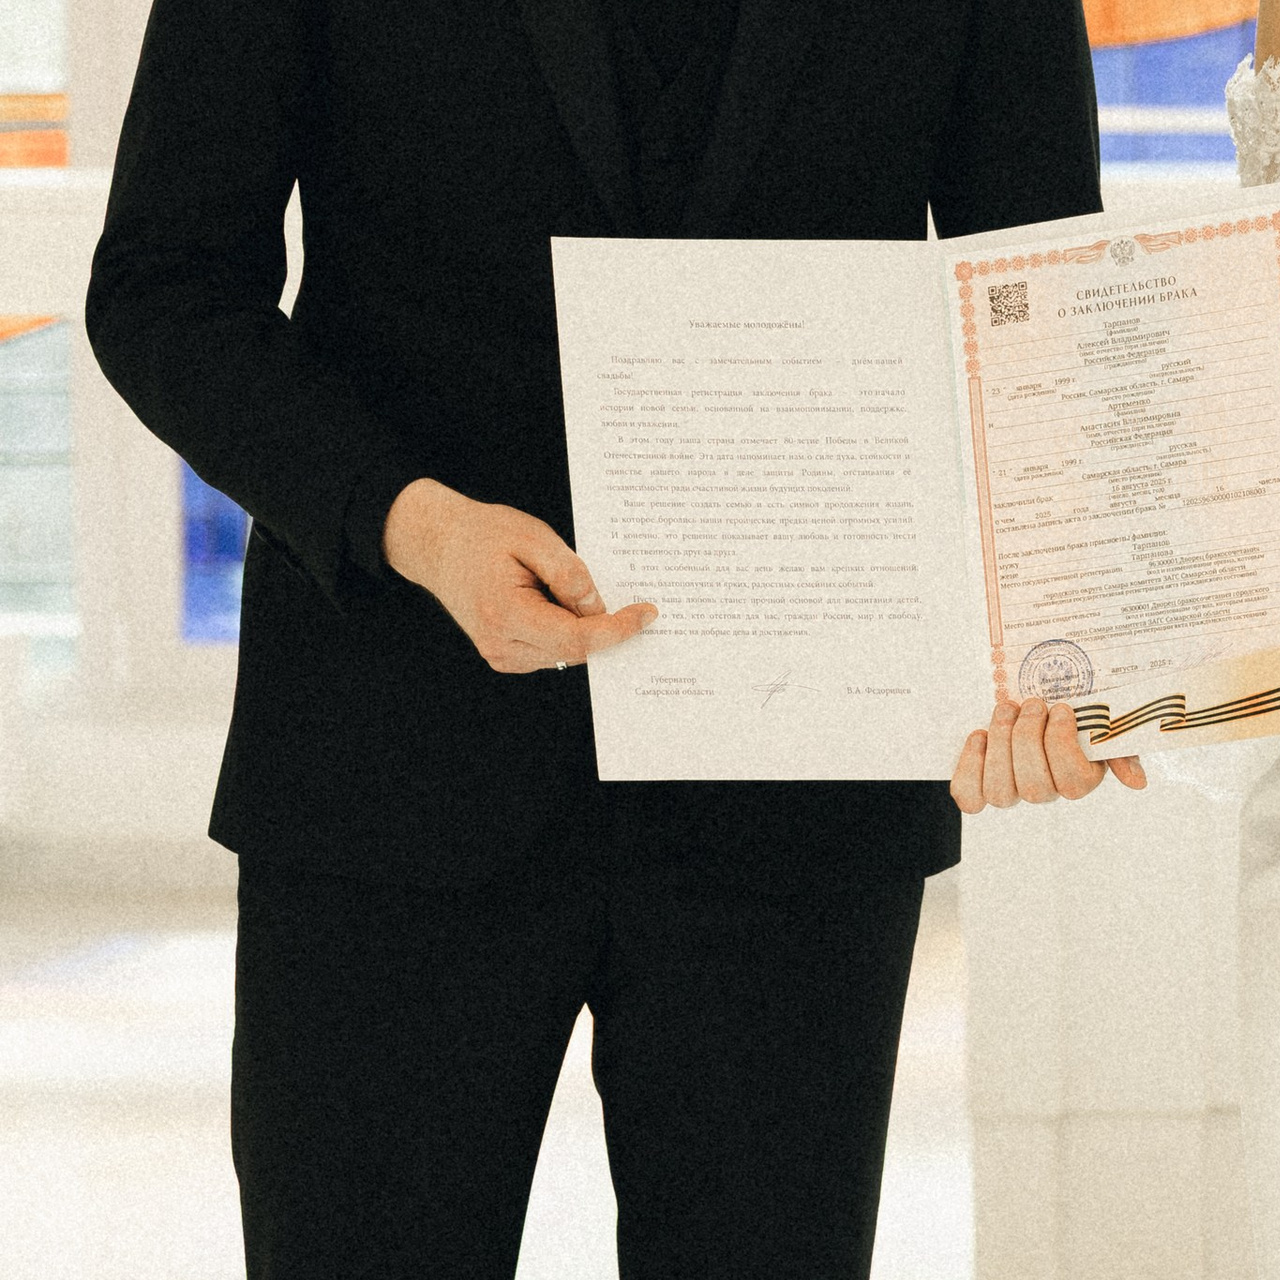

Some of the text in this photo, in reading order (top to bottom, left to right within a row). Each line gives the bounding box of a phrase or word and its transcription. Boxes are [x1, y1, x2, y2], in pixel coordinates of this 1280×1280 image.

[1076, 276, 1177, 301] СВИДЕТЕЛЬСТВО
[1070, 294, 1156, 317] ЗАКЛЮЧЕНИИ
[1159, 287, 1198, 303] БРАКА
[688, 320, 742, 330] Уважаемые
[1102, 318, 1141, 330] Тарпанов
[1076, 330, 1171, 350] Алексей Владимирович
[650, 674, 697, 686] Губернатор
[634, 686, 715, 698] Самарской области
